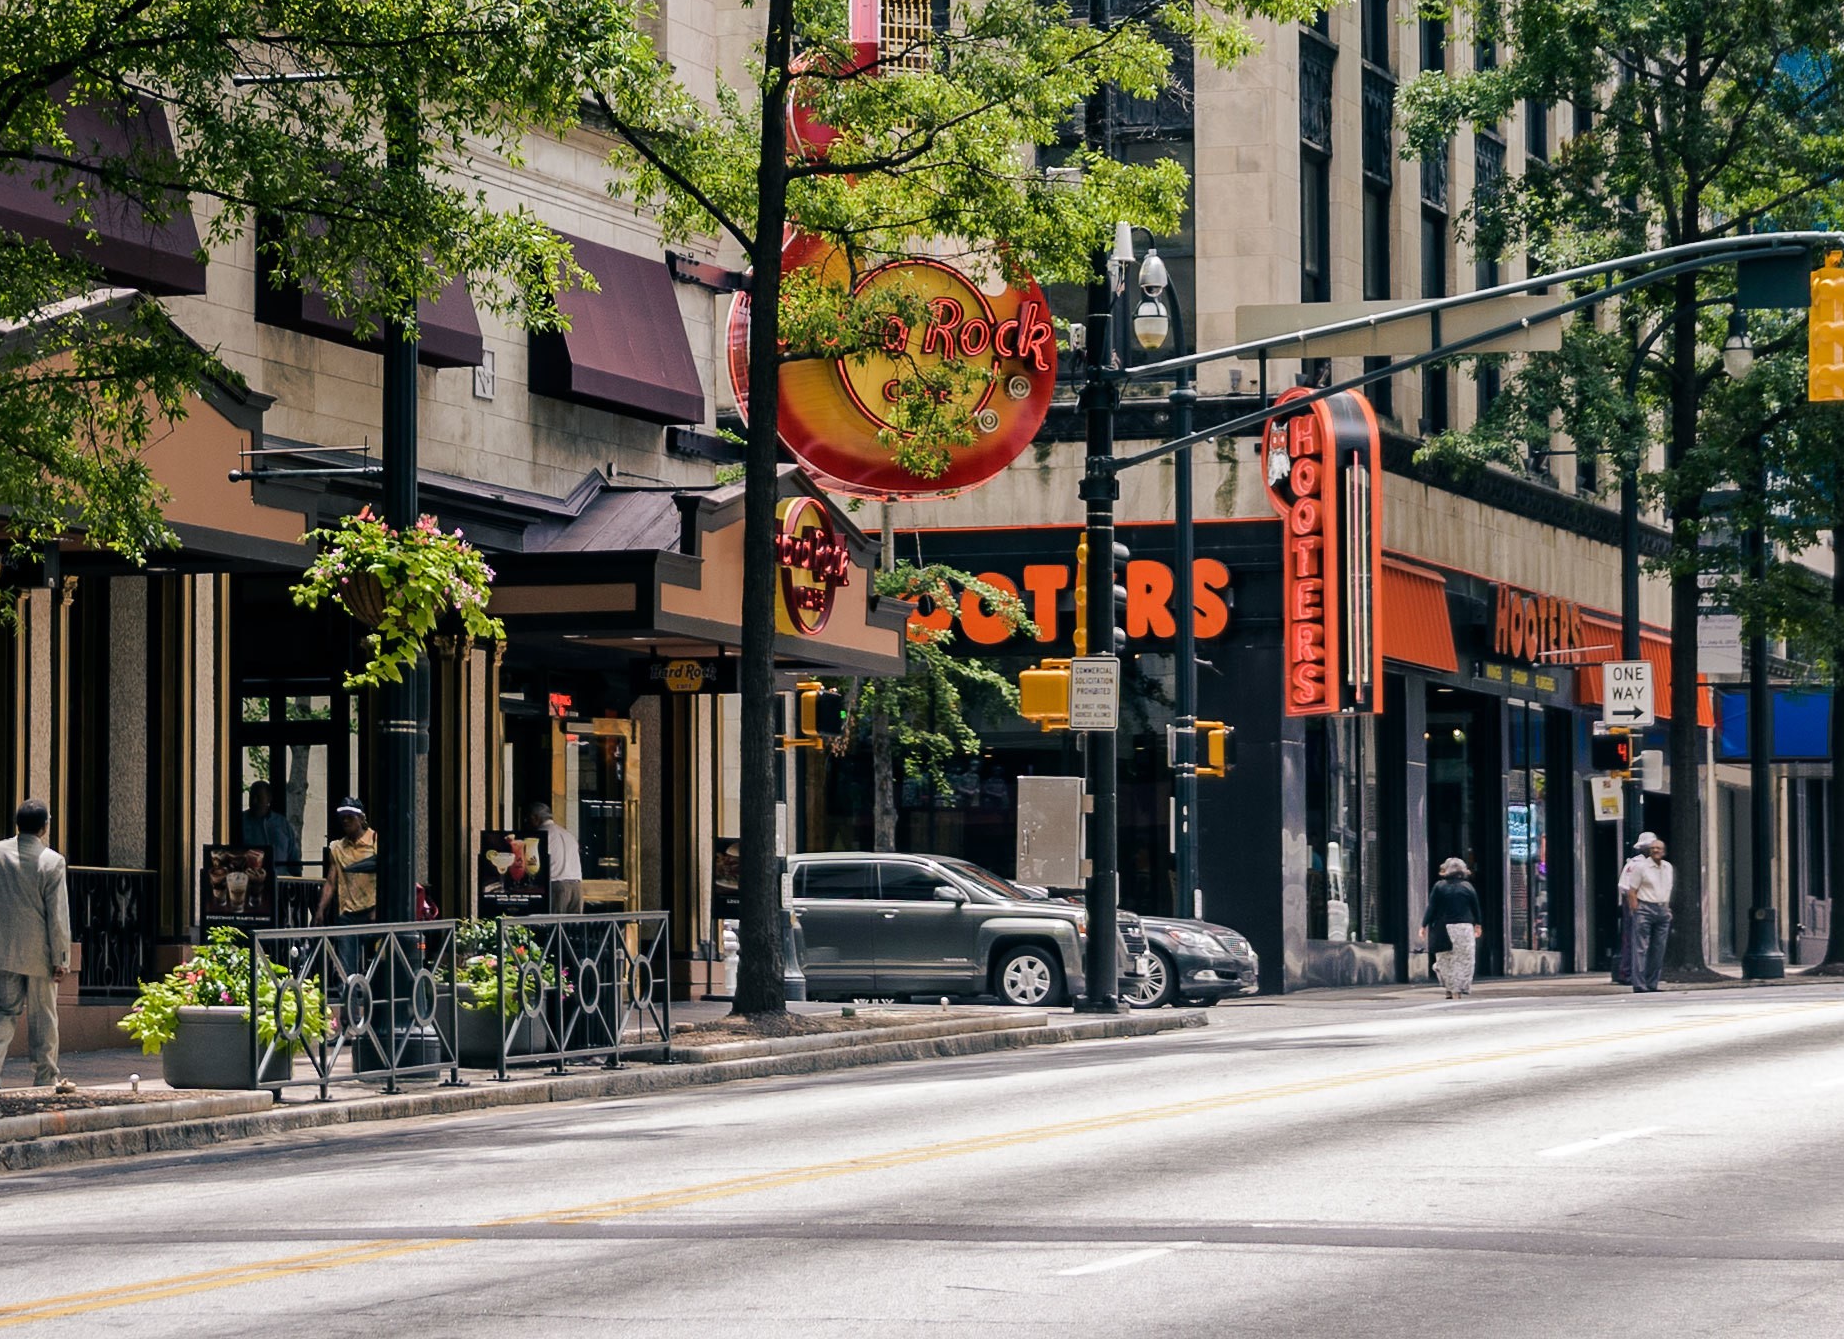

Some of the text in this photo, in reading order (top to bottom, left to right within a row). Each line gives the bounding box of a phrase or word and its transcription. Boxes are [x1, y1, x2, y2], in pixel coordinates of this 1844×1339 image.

[925, 297, 1053, 371] Rock
[1289, 413, 1326, 705] HOOTERS
[1494, 582, 1582, 664] HOOTERS
[685, 663, 718, 682] Rock
[1075, 666, 1113, 675] COMMERCIAL
[1612, 666, 1645, 682] ONE
[1612, 686, 1645, 701] WAY
[1617, 743, 1628, 762] 4
